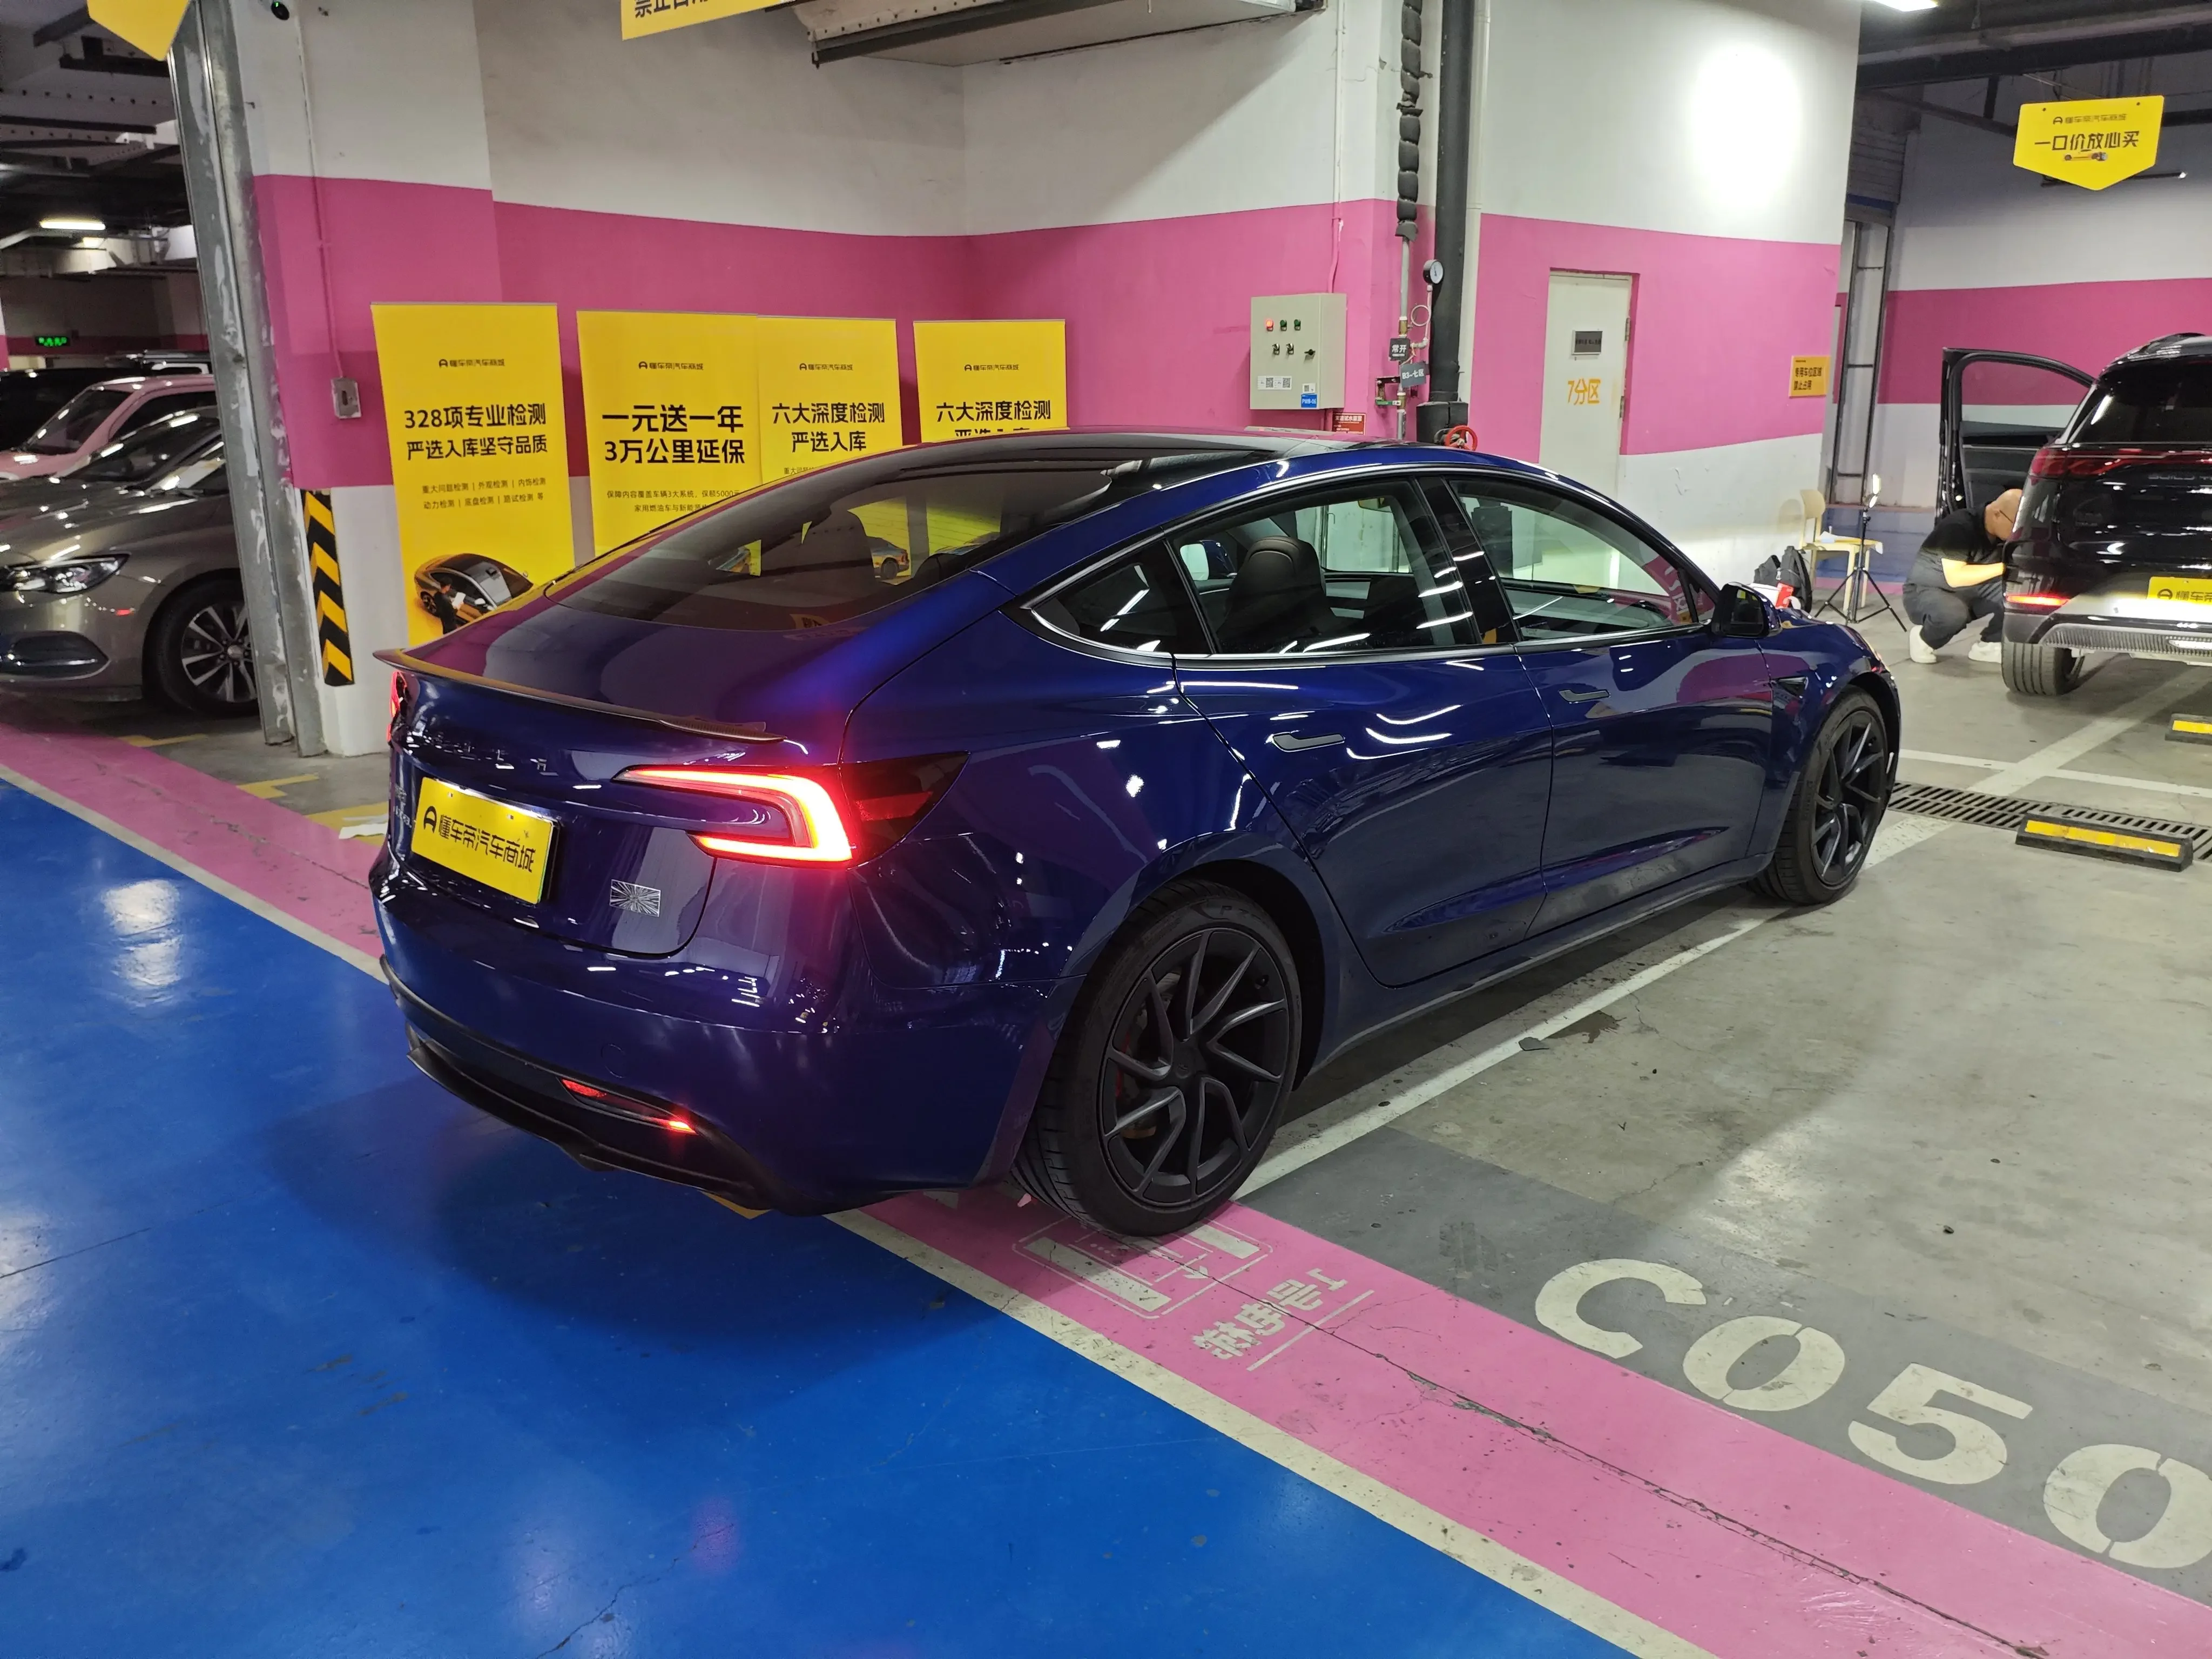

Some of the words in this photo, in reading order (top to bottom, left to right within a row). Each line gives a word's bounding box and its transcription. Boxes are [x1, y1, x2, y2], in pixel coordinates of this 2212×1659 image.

[2034, 131, 2140, 151] 一口价放心买
[1568, 377, 1601, 406] 7分区
[404, 402, 547, 429] 328项专业检测
[602, 404, 744, 433] 一元送一年
[772, 402, 885, 424] 六大深度检测
[936, 400, 1051, 422] 六大深度检测
[406, 434, 548, 461] 严选入库坚守品质
[604, 438, 745, 464] 3万公里延保
[792, 430, 867, 453] 严选入库
[478, 480, 508, 490] 外观检测
[518, 477, 546, 487] 内饰检测
[423, 499, 455, 510] 动力检测
[464, 496, 494, 507] 底盘检测
[503, 494, 534, 503] 路试检测
[439, 814, 536, 873] 懂车帝汽车商城
